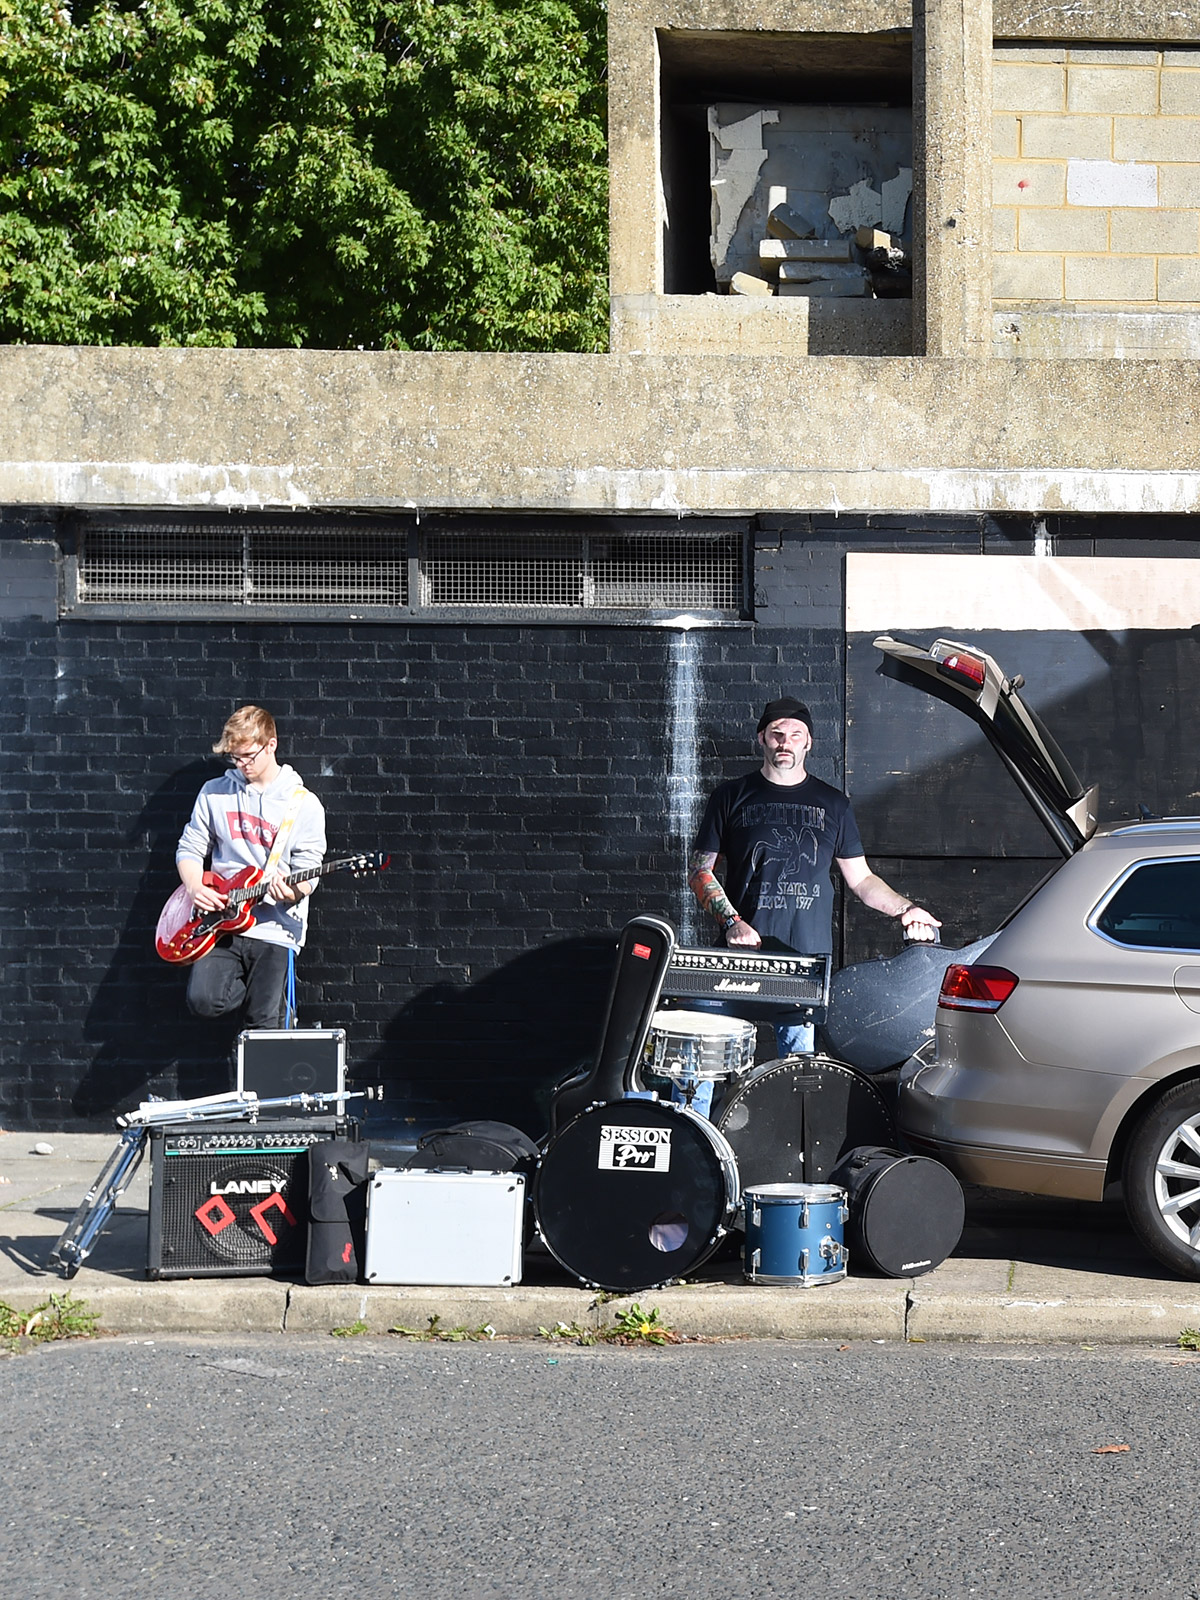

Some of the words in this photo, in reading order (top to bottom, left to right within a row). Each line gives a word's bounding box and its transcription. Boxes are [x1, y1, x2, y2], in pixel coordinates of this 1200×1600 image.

[777, 882, 808, 896] STATES
[796, 897, 814, 910] 1977
[713, 978, 761, 993] Marshall
[600, 1128, 671, 1144] SESSION
[615, 1144, 655, 1167] Pro
[210, 1180, 287, 1195] LANEY
